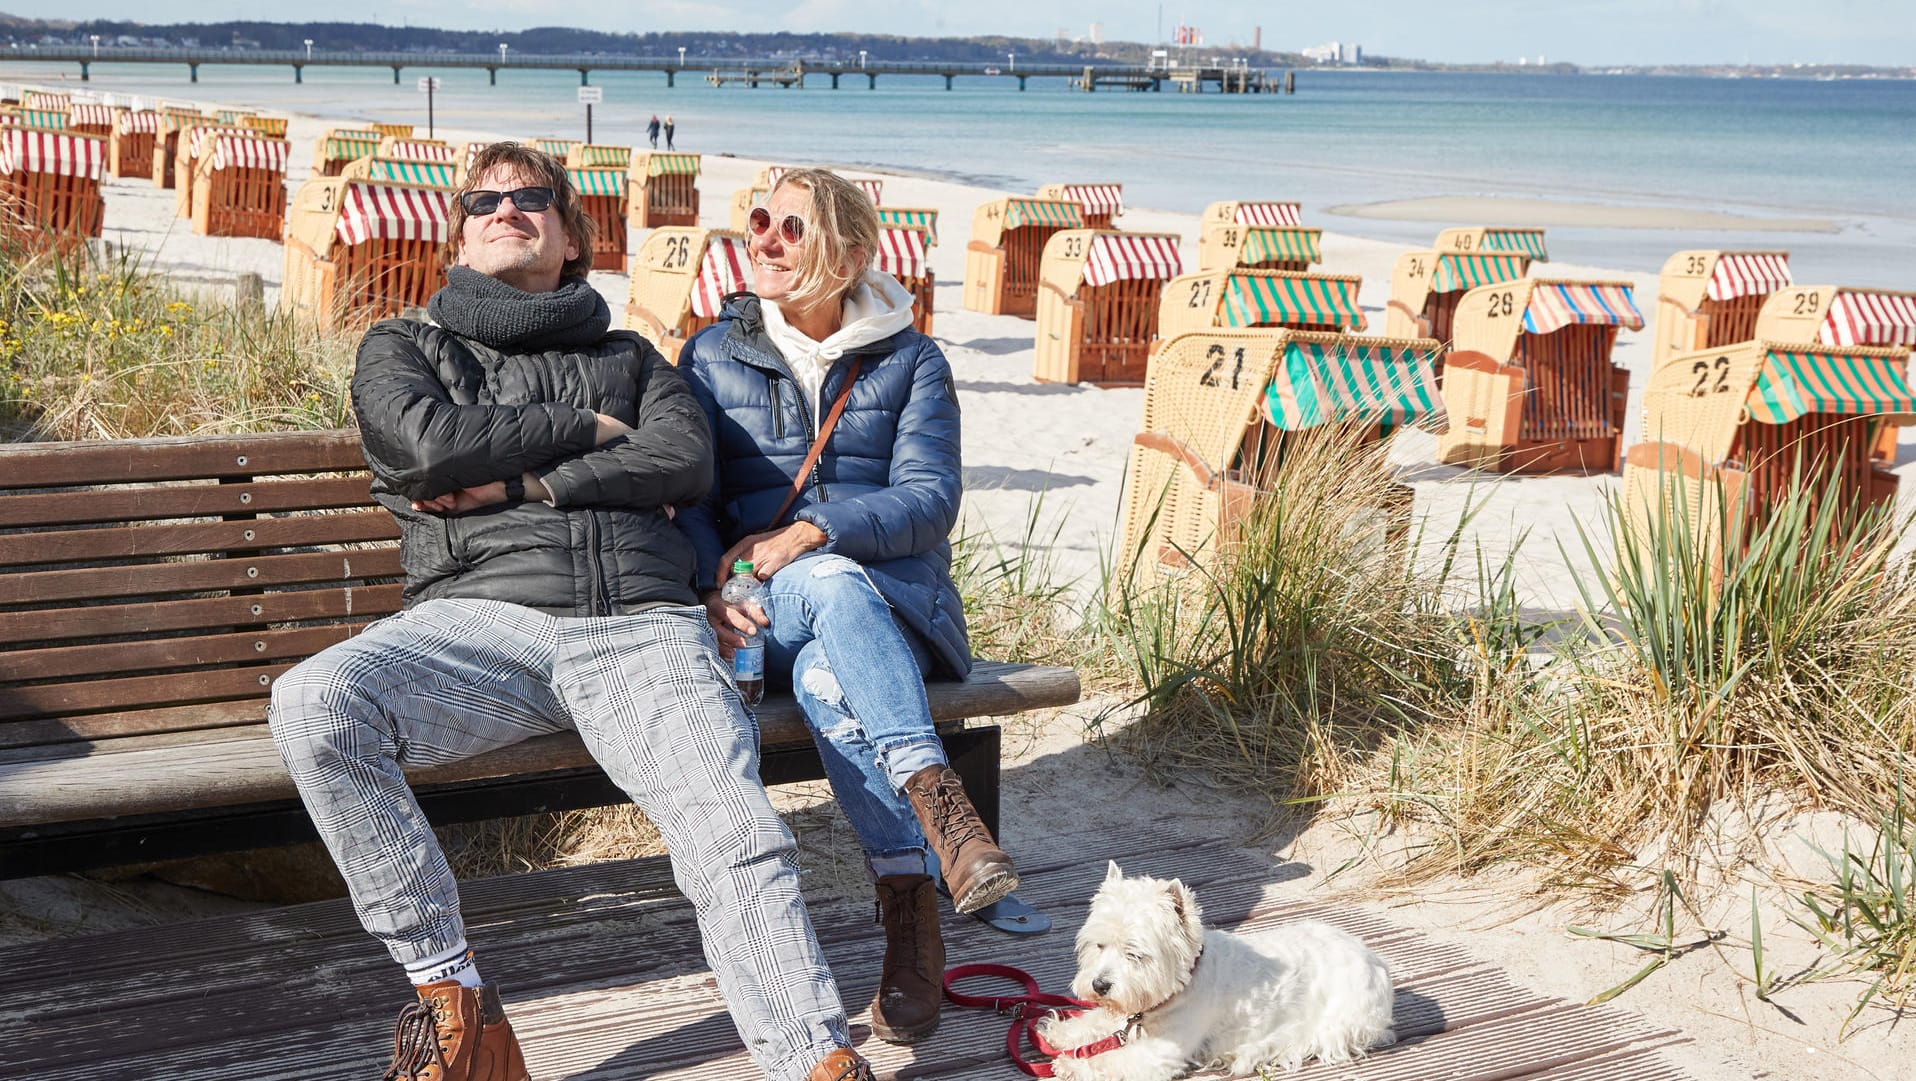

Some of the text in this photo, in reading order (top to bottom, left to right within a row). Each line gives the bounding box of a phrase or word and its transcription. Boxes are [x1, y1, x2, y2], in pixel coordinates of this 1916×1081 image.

[322, 186, 336, 211] 31
[1218, 206, 1231, 220] 45
[662, 236, 690, 269] 26
[1064, 237, 1081, 258] 33
[1454, 234, 1472, 250] 40
[1408, 258, 1424, 278] 34
[1686, 256, 1706, 275] 35
[1188, 280, 1211, 308] 27
[1488, 292, 1512, 318] 28
[1793, 292, 1819, 315] 29
[1199, 343, 1244, 390] 21
[1691, 356, 1730, 398] 22
